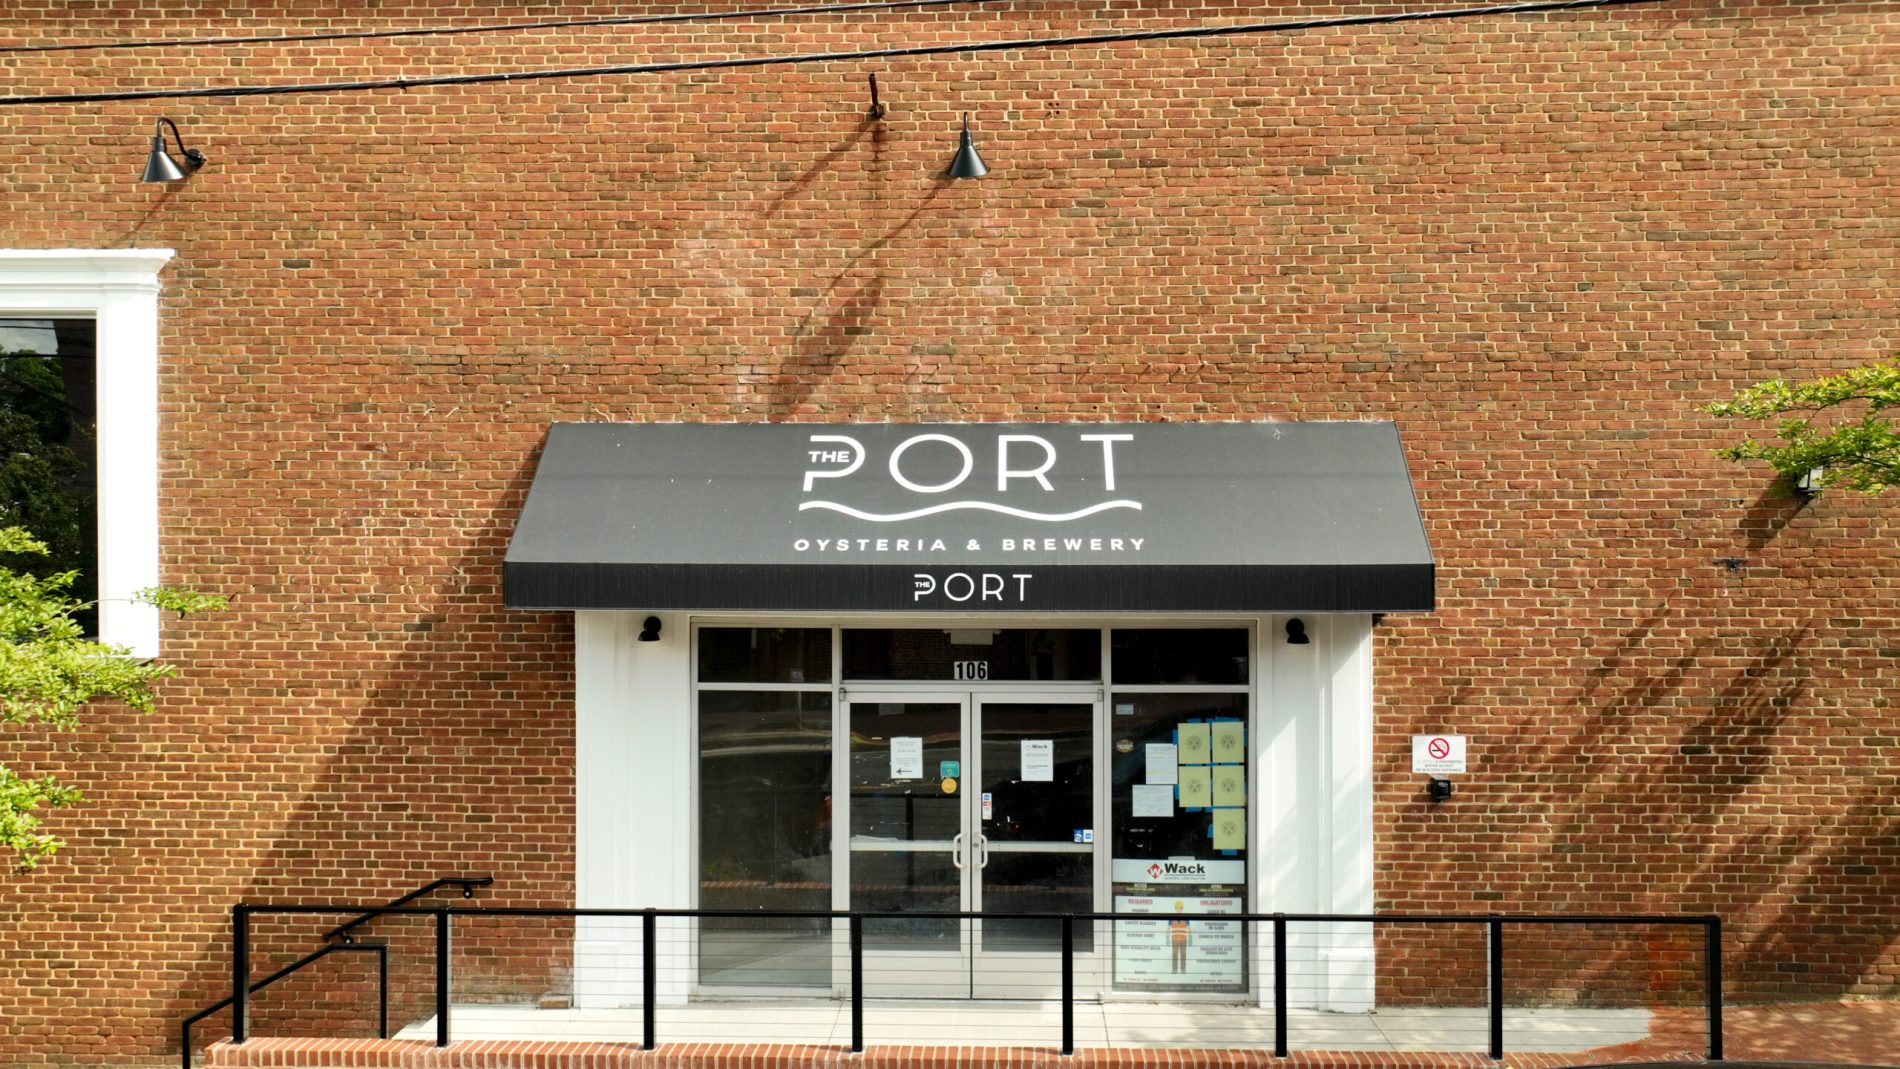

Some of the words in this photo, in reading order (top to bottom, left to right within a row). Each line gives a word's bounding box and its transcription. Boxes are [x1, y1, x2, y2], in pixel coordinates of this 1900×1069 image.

[803, 434, 1134, 492] PORT
[808, 451, 849, 463] THE
[794, 538, 947, 552] OYSTERIA
[966, 538, 982, 552] &
[1002, 538, 1145, 552] BREWERY
[914, 573, 1033, 602] PORT
[956, 661, 986, 680] 106
[1164, 862, 1206, 874] Wack
